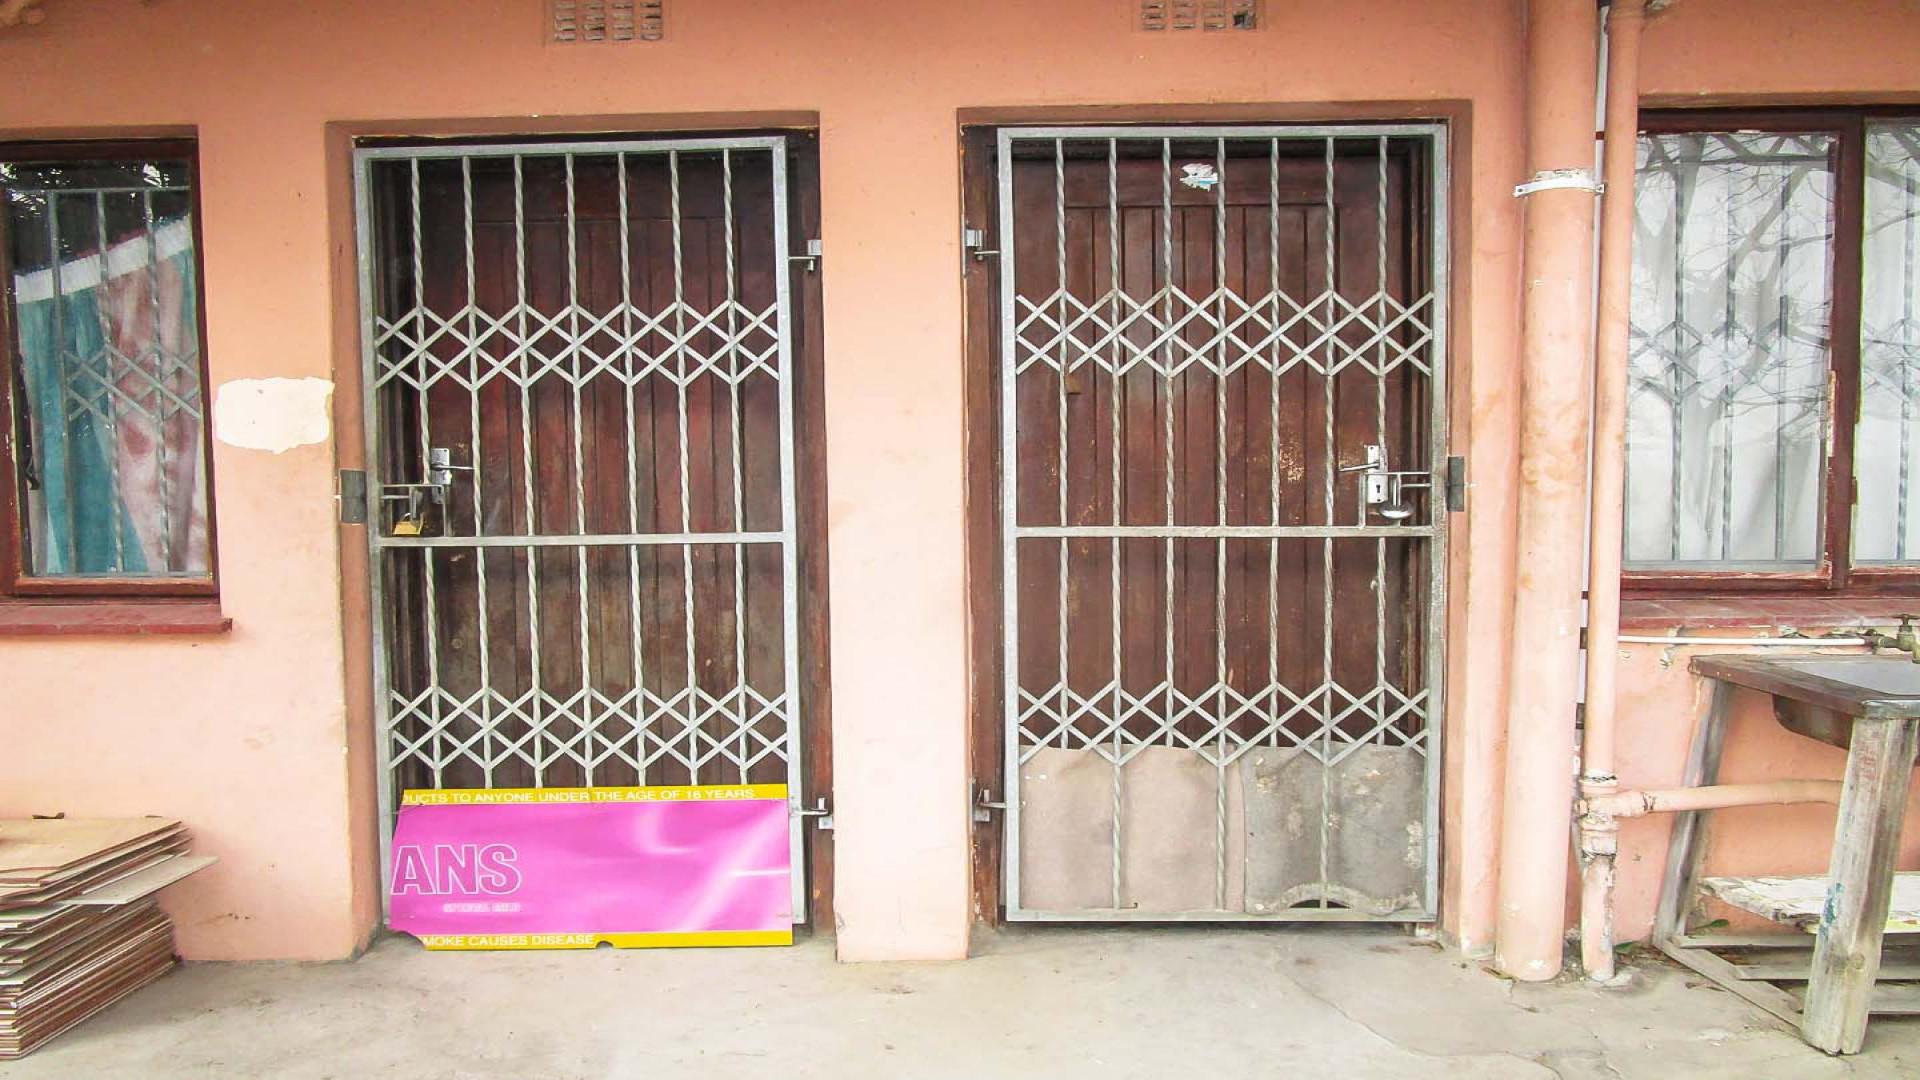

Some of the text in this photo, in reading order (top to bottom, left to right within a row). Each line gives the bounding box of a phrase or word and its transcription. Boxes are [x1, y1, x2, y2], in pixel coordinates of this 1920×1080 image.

[449, 793, 471, 803] TO
[475, 792, 532, 803] ANYONE
[538, 792, 589, 802] UNDER
[596, 791, 622, 801] THE
[624, 791, 656, 801] AGE
[660, 790, 680, 800] OF
[705, 789, 754, 799] YEARS
[390, 843, 522, 895] ANS
[468, 935, 527, 945] CAUSES
[532, 934, 594, 945] DISEASE
